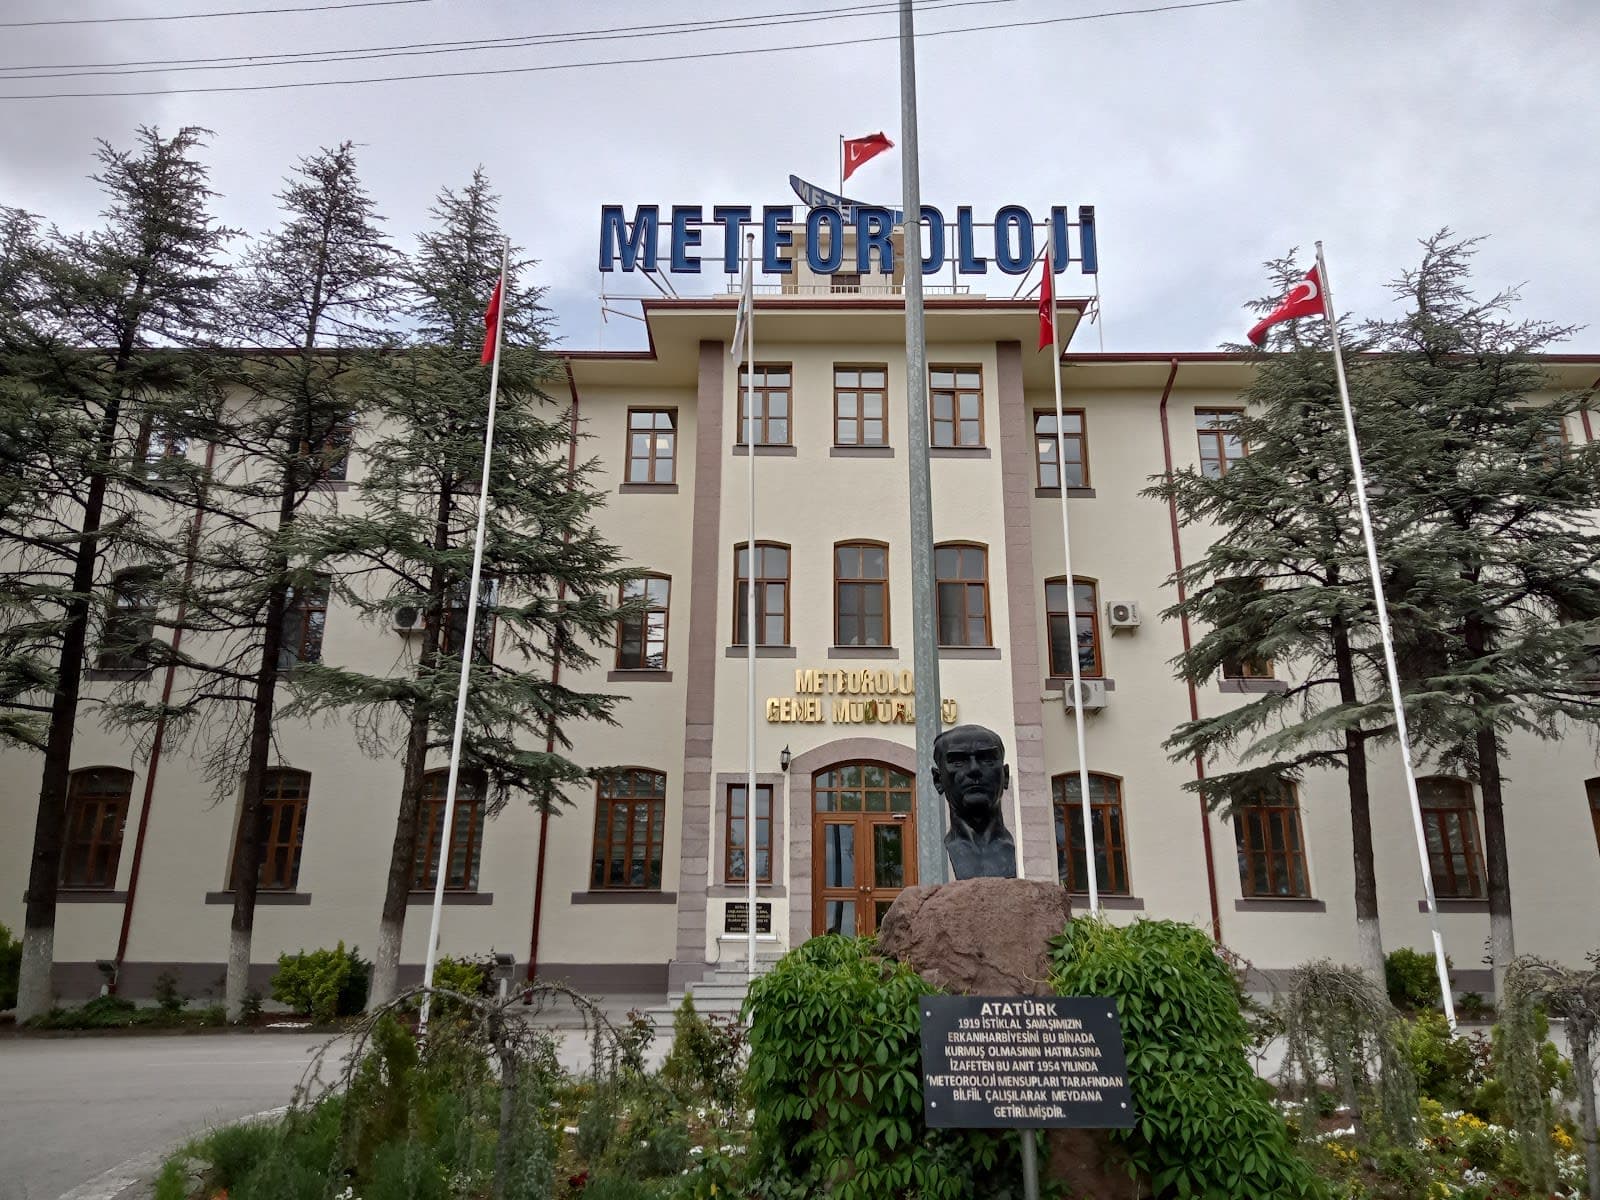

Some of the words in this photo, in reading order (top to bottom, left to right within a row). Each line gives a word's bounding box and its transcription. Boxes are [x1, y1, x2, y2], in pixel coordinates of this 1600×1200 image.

[795, 669, 914, 695] METEOROLO
[766, 697, 825, 723] GENEL
[981, 1000, 1058, 1017] ATATÜRK
[958, 1018, 980, 1029] 1919
[982, 1017, 1022, 1029] İSTİKLAL
[1025, 1019, 1082, 1031] SAVAŞIMIZIN
[1043, 1033, 1056, 1043] BU
[1058, 1031, 1095, 1044] BİNADA
[945, 1046, 985, 1059] KURMUŞ
[988, 1046, 1041, 1057] OLMASININ
[1044, 1046, 1102, 1057] HATIRASINA
[950, 1058, 995, 1071] İZAFETEN
[996, 1061, 1010, 1071] BU
[1012, 1061, 1034, 1071] ANIT
[1037, 1061, 1060, 1072] 1954
[1061, 1061, 1098, 1072] YILINDA
[998, 1076, 1059, 1087] MENSUPLARI
[1060, 1076, 1123, 1087] TARAFINDAN
[985, 1089, 1047, 1103] ÇALIŞILARAK
[1051, 1090, 1103, 1102] MEYDANA
